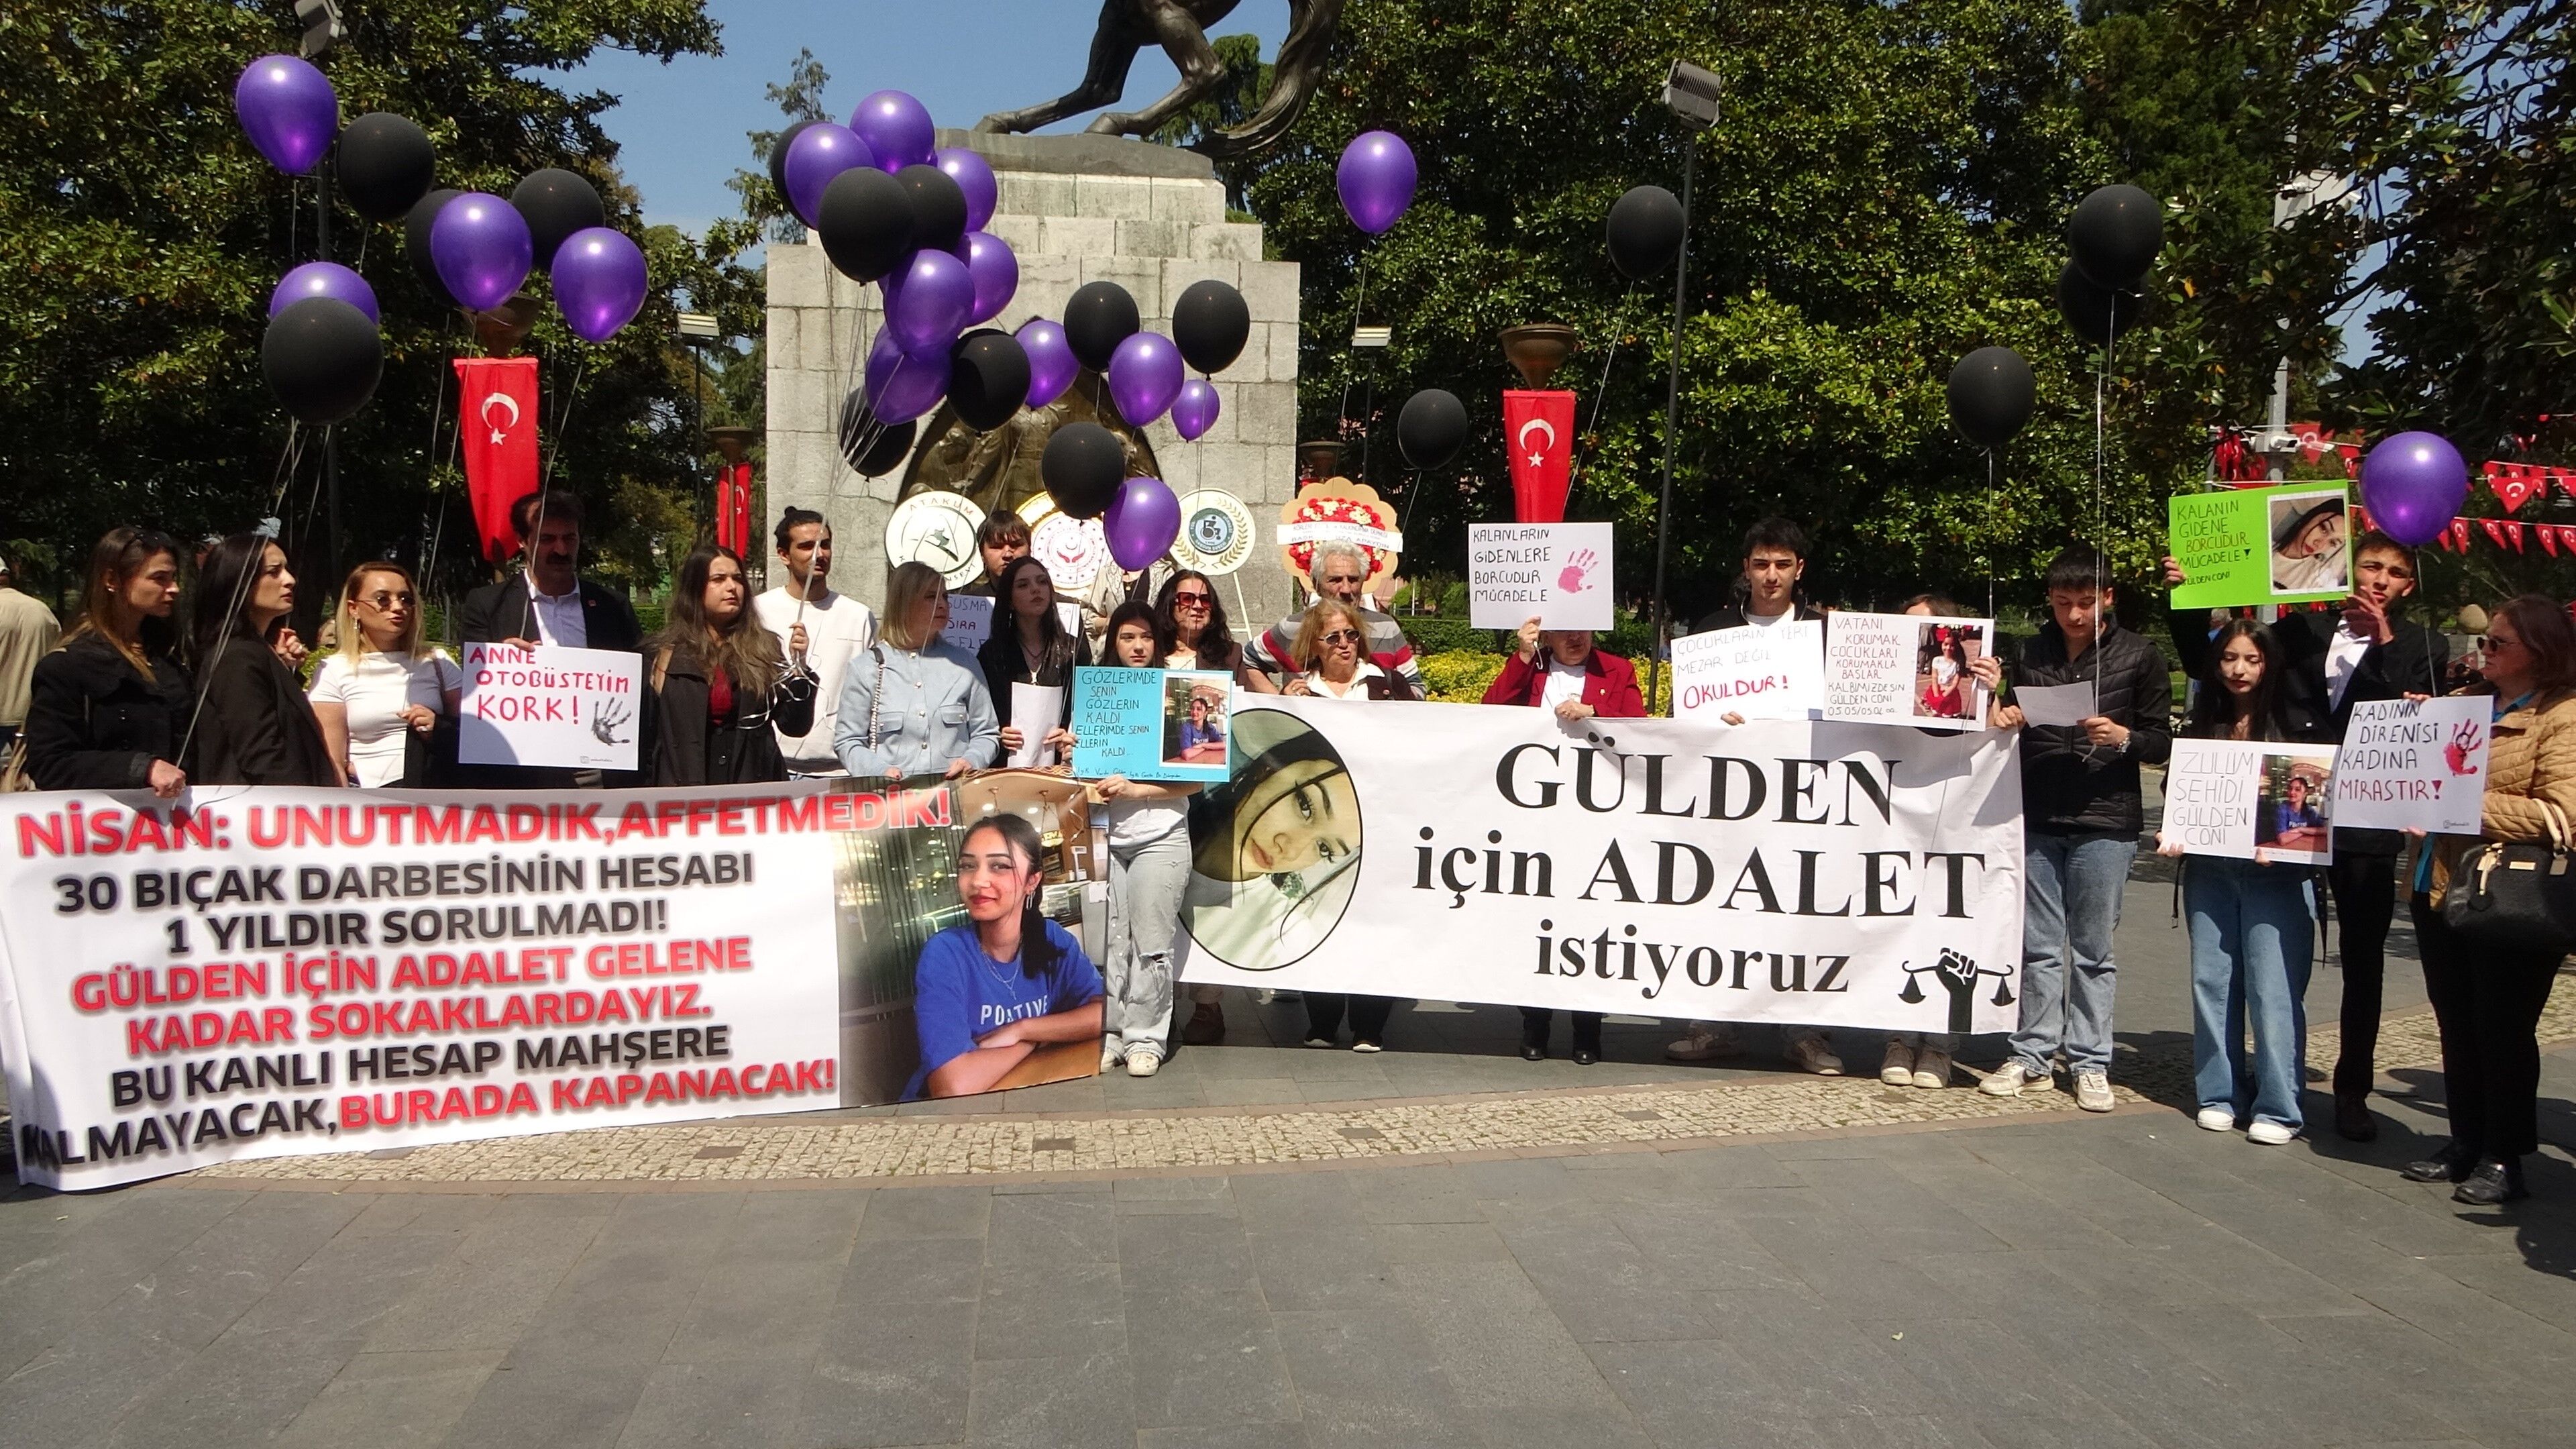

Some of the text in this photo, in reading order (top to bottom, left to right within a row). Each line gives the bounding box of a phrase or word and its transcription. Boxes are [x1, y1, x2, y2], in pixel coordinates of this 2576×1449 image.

[910, 498, 973, 515] ATAKUM
[2178, 500, 2239, 521] KALANIN
[1473, 528, 1550, 543] KALANLARIN
[2187, 531, 2250, 553] BORCUDUR
[1474, 570, 1541, 584] BORCUDUR
[1474, 589, 1548, 602] MÜCADELE
[1835, 618, 1882, 631] VATANI
[1677, 629, 1765, 656] ÇOCUKLARIN
[1845, 634, 1900, 645] KORUMAK
[470, 647, 536, 664] ANNE
[1677, 656, 1723, 677] MEZAR
[1836, 659, 1897, 669] KORUMAKLA
[476, 667, 629, 693] OTOBÜSTEYİM
[1086, 712, 1120, 724] KALDI
[2351, 702, 2422, 724] KADININ
[2180, 748, 2253, 775] ZULÜM
[2341, 748, 2418, 770] KADINA
[1495, 731, 1902, 827] GÜLDEN
[2173, 803, 2247, 828] GÜLDEN
[17, 801, 231, 857] NİSAN:
[56, 853, 753, 912] 30 BIÇAK DARBESİNİN HESABI
[1413, 826, 1986, 919] için ADALET
[167, 900, 666, 953] 1 YILDIR SORULMADI!
[1534, 919, 1851, 1000] istiyoruz
[74, 937, 751, 1011] GÜLDEN İÇİN ADALET GELENE
[127, 984, 712, 1055] KADAR SOKAKLARDAYIZ.
[113, 1026, 730, 1107] BU KANLI HESAP MAHŞERE
[553, 1059, 835, 1110] KAPANACAK!
